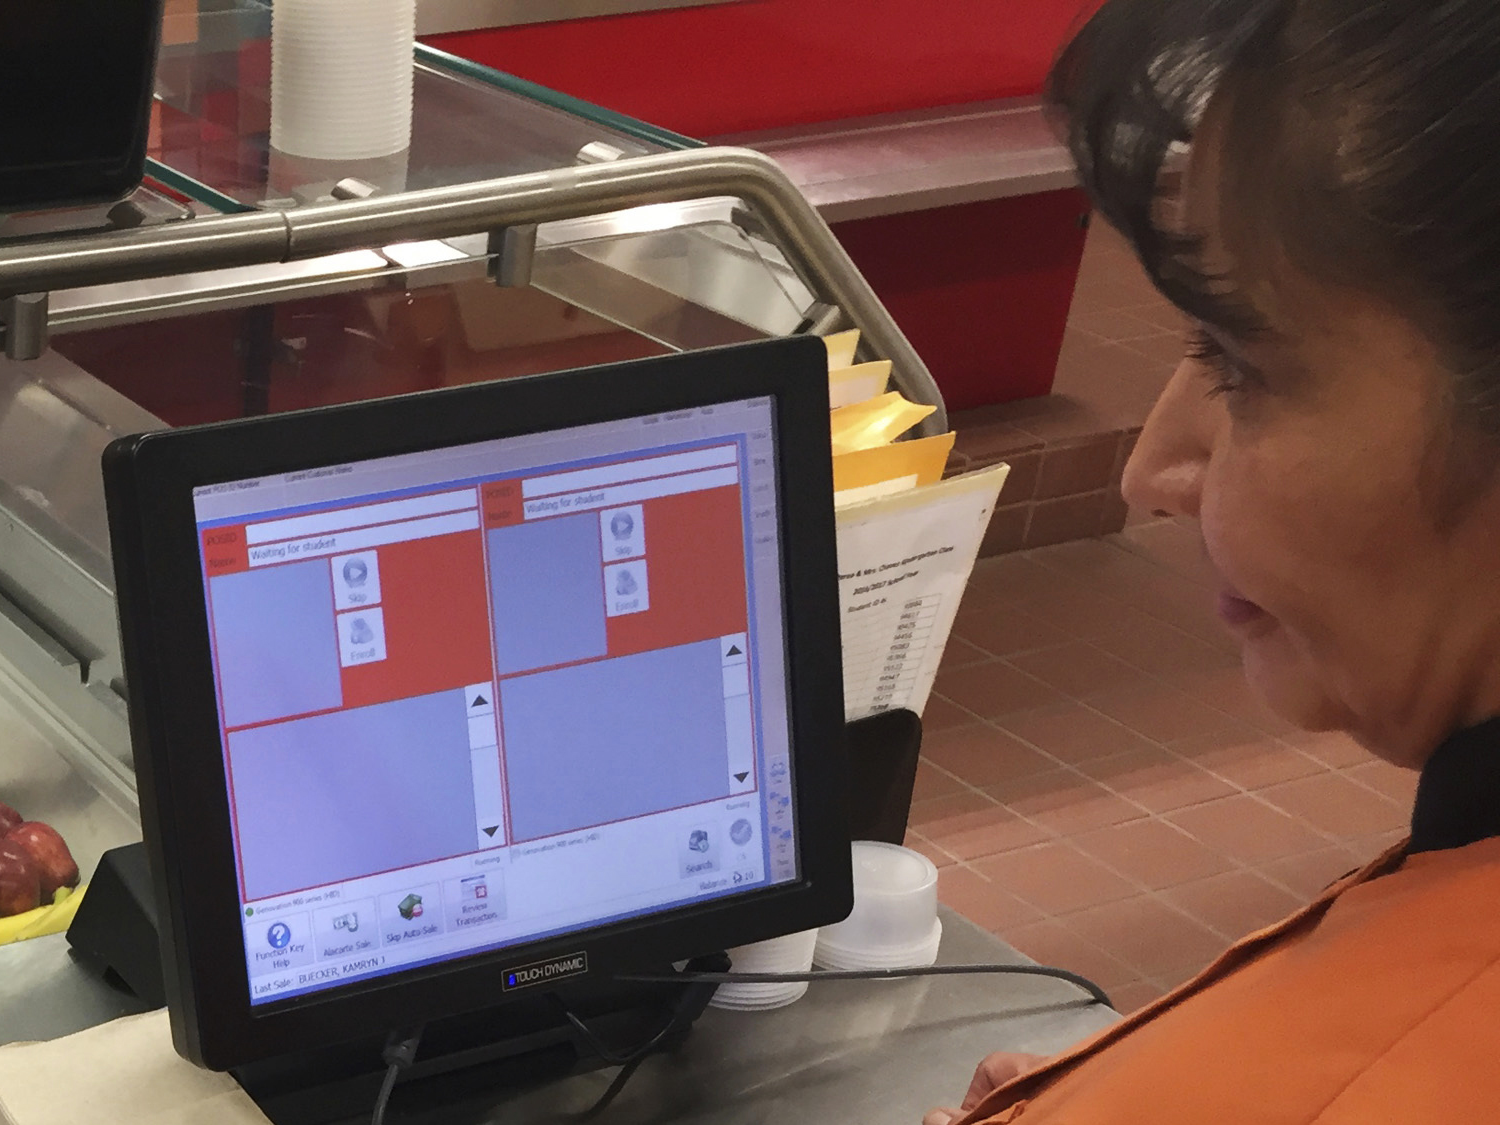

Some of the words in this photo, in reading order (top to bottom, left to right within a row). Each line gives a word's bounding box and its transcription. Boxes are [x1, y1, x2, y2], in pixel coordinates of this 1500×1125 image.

[526, 497, 559, 515] Waiting
[561, 494, 573, 509] for
[574, 491, 605, 507] student
[252, 544, 285, 561] Waiting
[287, 540, 301, 555] for
[302, 537, 336, 552] student
[686, 860, 713, 873] Search
[455, 910, 498, 927] Transaction
[422, 924, 439, 935] Sale
[255, 948, 288, 961] Function
[289, 943, 306, 956] Key
[272, 958, 291, 970] Help
[515, 966, 544, 984] TOUCH
[544, 957, 585, 977] DYNAMIC
[254, 982, 271, 995] Last
[342, 957, 379, 973] KAMRYN
